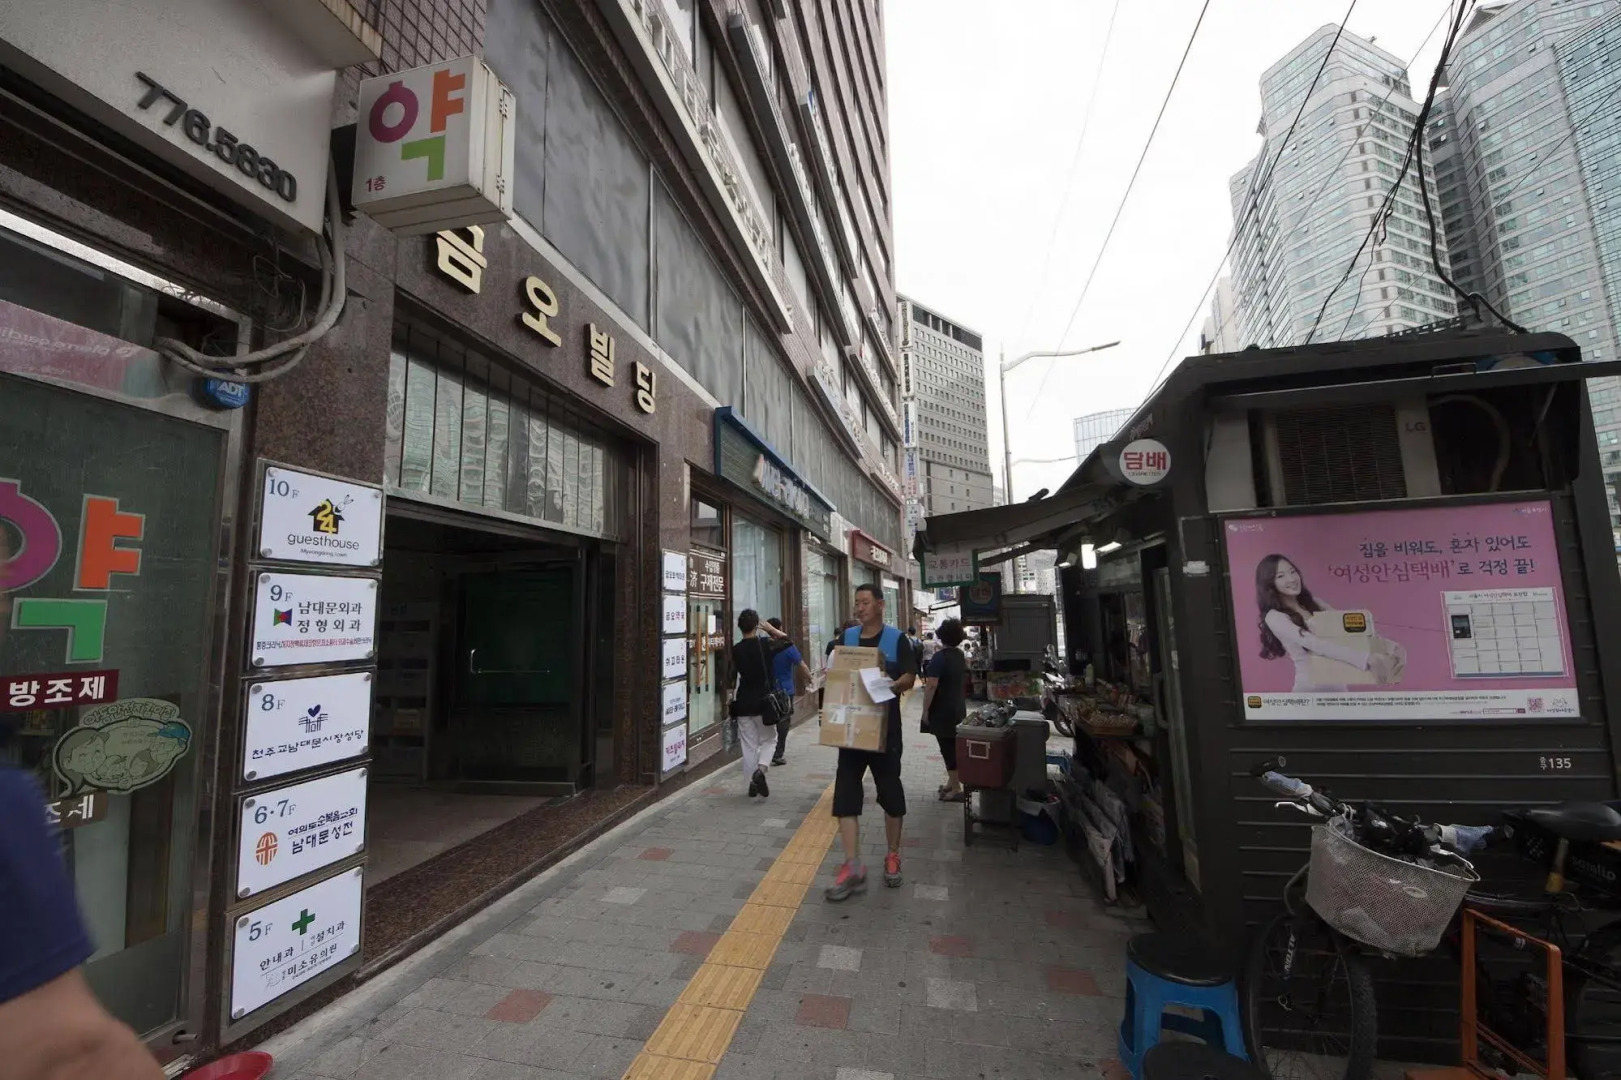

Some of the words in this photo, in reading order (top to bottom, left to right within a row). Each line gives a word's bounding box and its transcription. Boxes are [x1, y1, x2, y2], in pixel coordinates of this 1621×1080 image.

[368, 68, 466, 181] 약
[133, 70, 298, 203] 776.5830
[365, 174, 387, 193] 1층
[216, 381, 246, 397] ADT
[1405, 421, 1427, 432] LG
[1123, 451, 1167, 470] 담배
[316, 500, 337, 535] 24
[287, 533, 360, 551] guesthouse
[1359, 541, 1388, 559] 집을
[1393, 538, 1443, 555] 비워도,
[1450, 535, 1480, 553] 혼자
[1485, 534, 1531, 552] 있어도
[0, 477, 146, 665] 약
[928, 558, 971, 570] 교통카드
[1479, 560, 1508, 578] 걱정
[1513, 557, 1535, 576] 끝!
[700, 573, 724, 592] 구제전문
[298, 601, 363, 616] 남대문외과
[1548, 757, 1572, 769] 135
[287, 807, 359, 836] 여의도순복음교회
[292, 821, 354, 855] 남대문성전
[259, 946, 295, 972] 안내과
[287, 942, 338, 976] 미소유의원
[1283, 932, 1297, 972] ALTON
